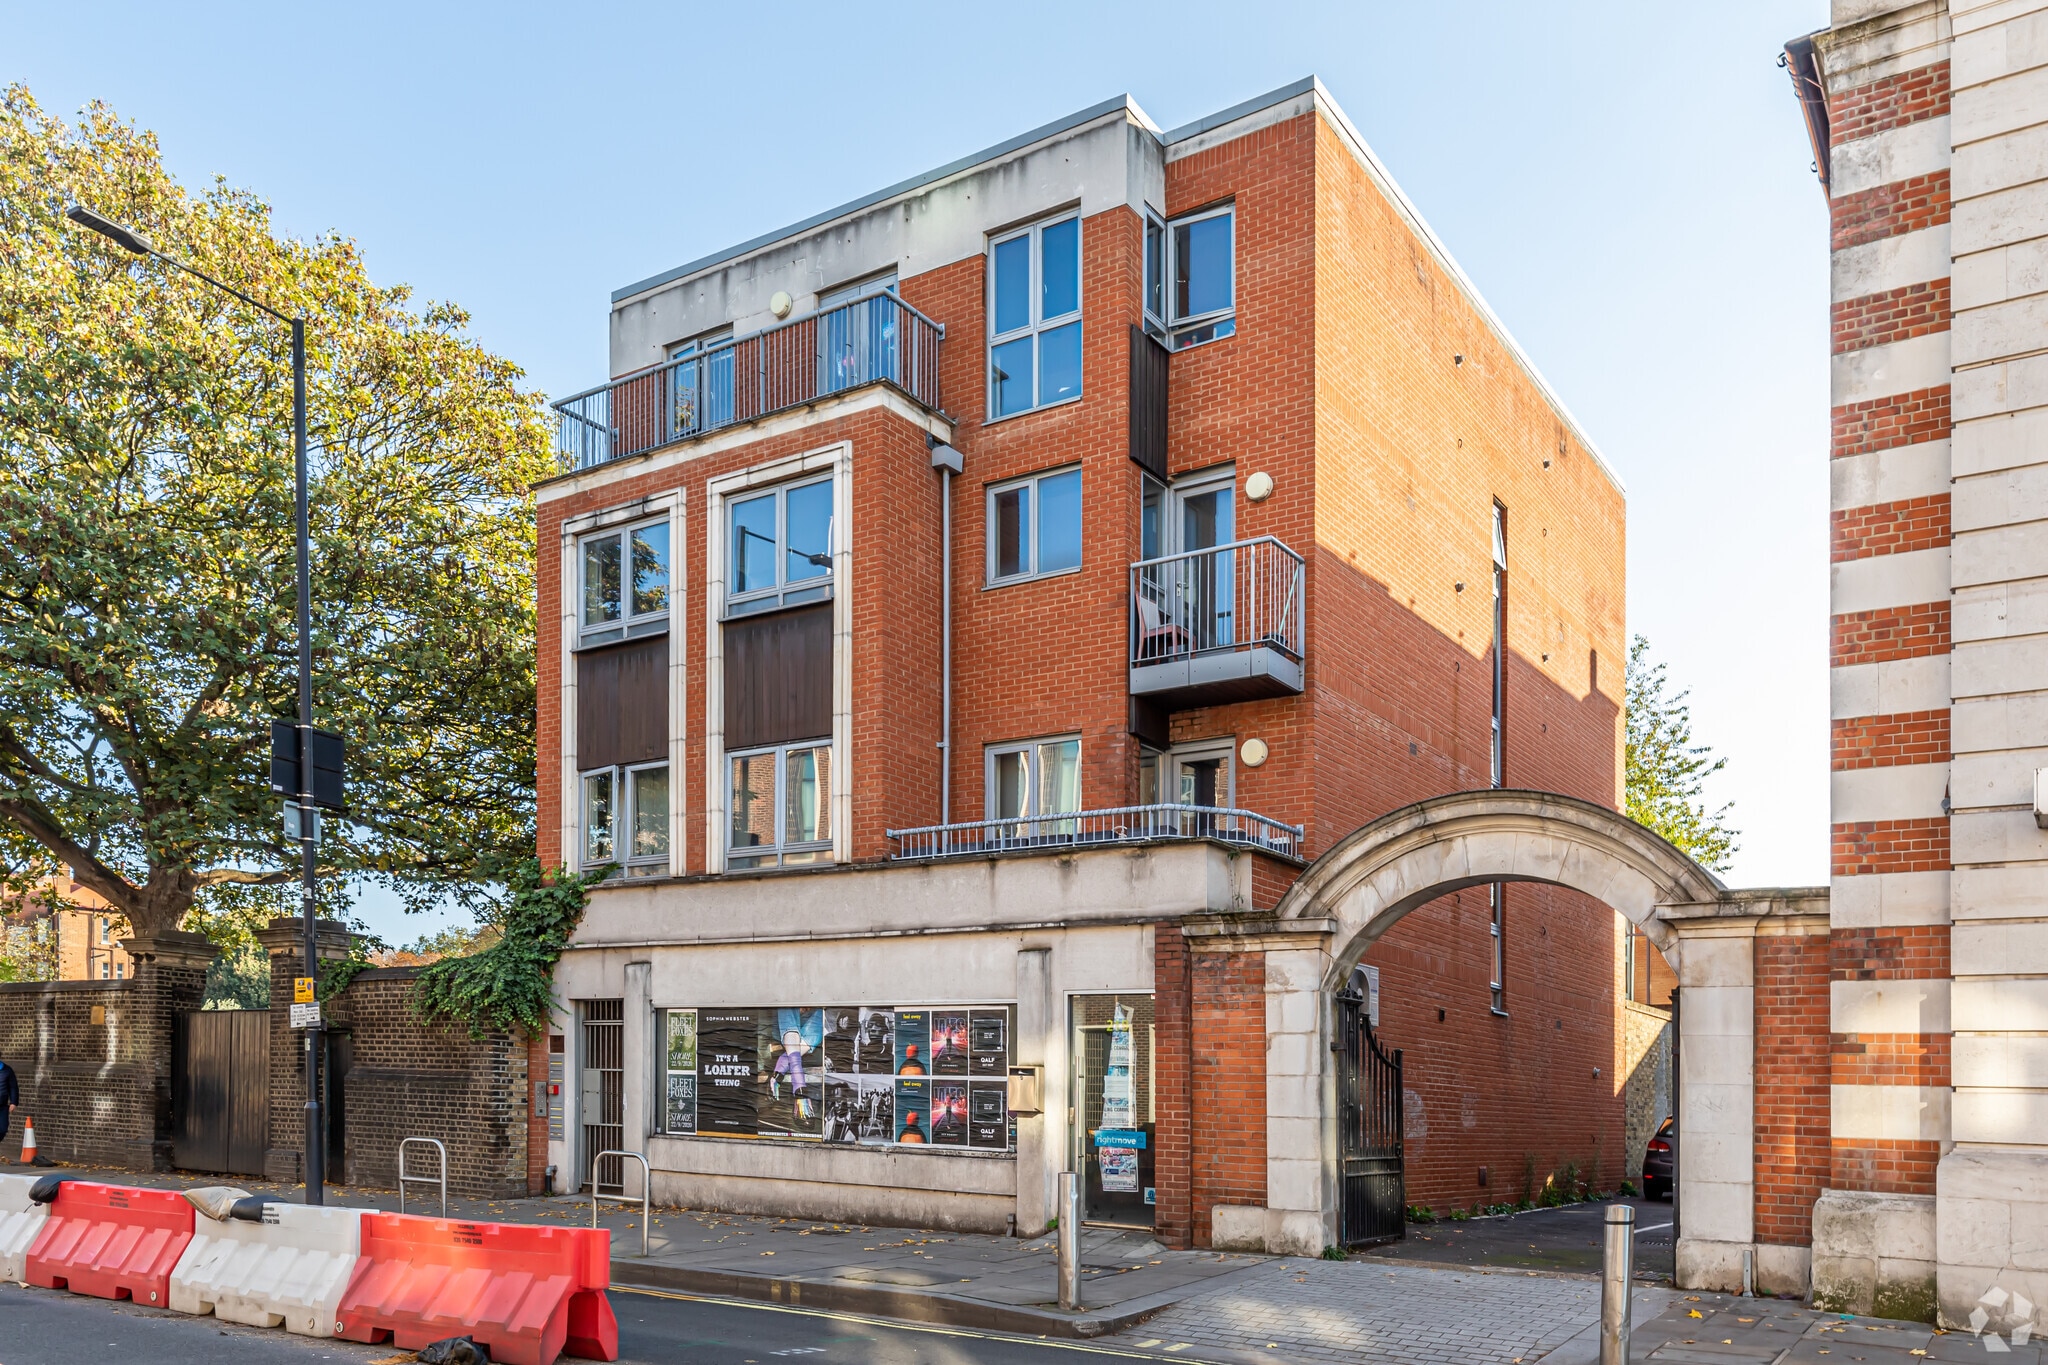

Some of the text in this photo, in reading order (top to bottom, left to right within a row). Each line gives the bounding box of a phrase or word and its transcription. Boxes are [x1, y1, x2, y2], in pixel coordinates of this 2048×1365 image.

[670, 1016, 692, 1026] FLEET
[1106, 1020, 1129, 1032] 219
[670, 1026, 692, 1036] FOXES
[716, 1054, 738, 1062] IT'S A
[704, 1064, 750, 1076] LOAFER
[670, 1078, 693, 1088] FLEET
[714, 1078, 740, 1086] THING
[670, 1088, 693, 1098] FOXES
[1096, 1135, 1136, 1144] rightmove
